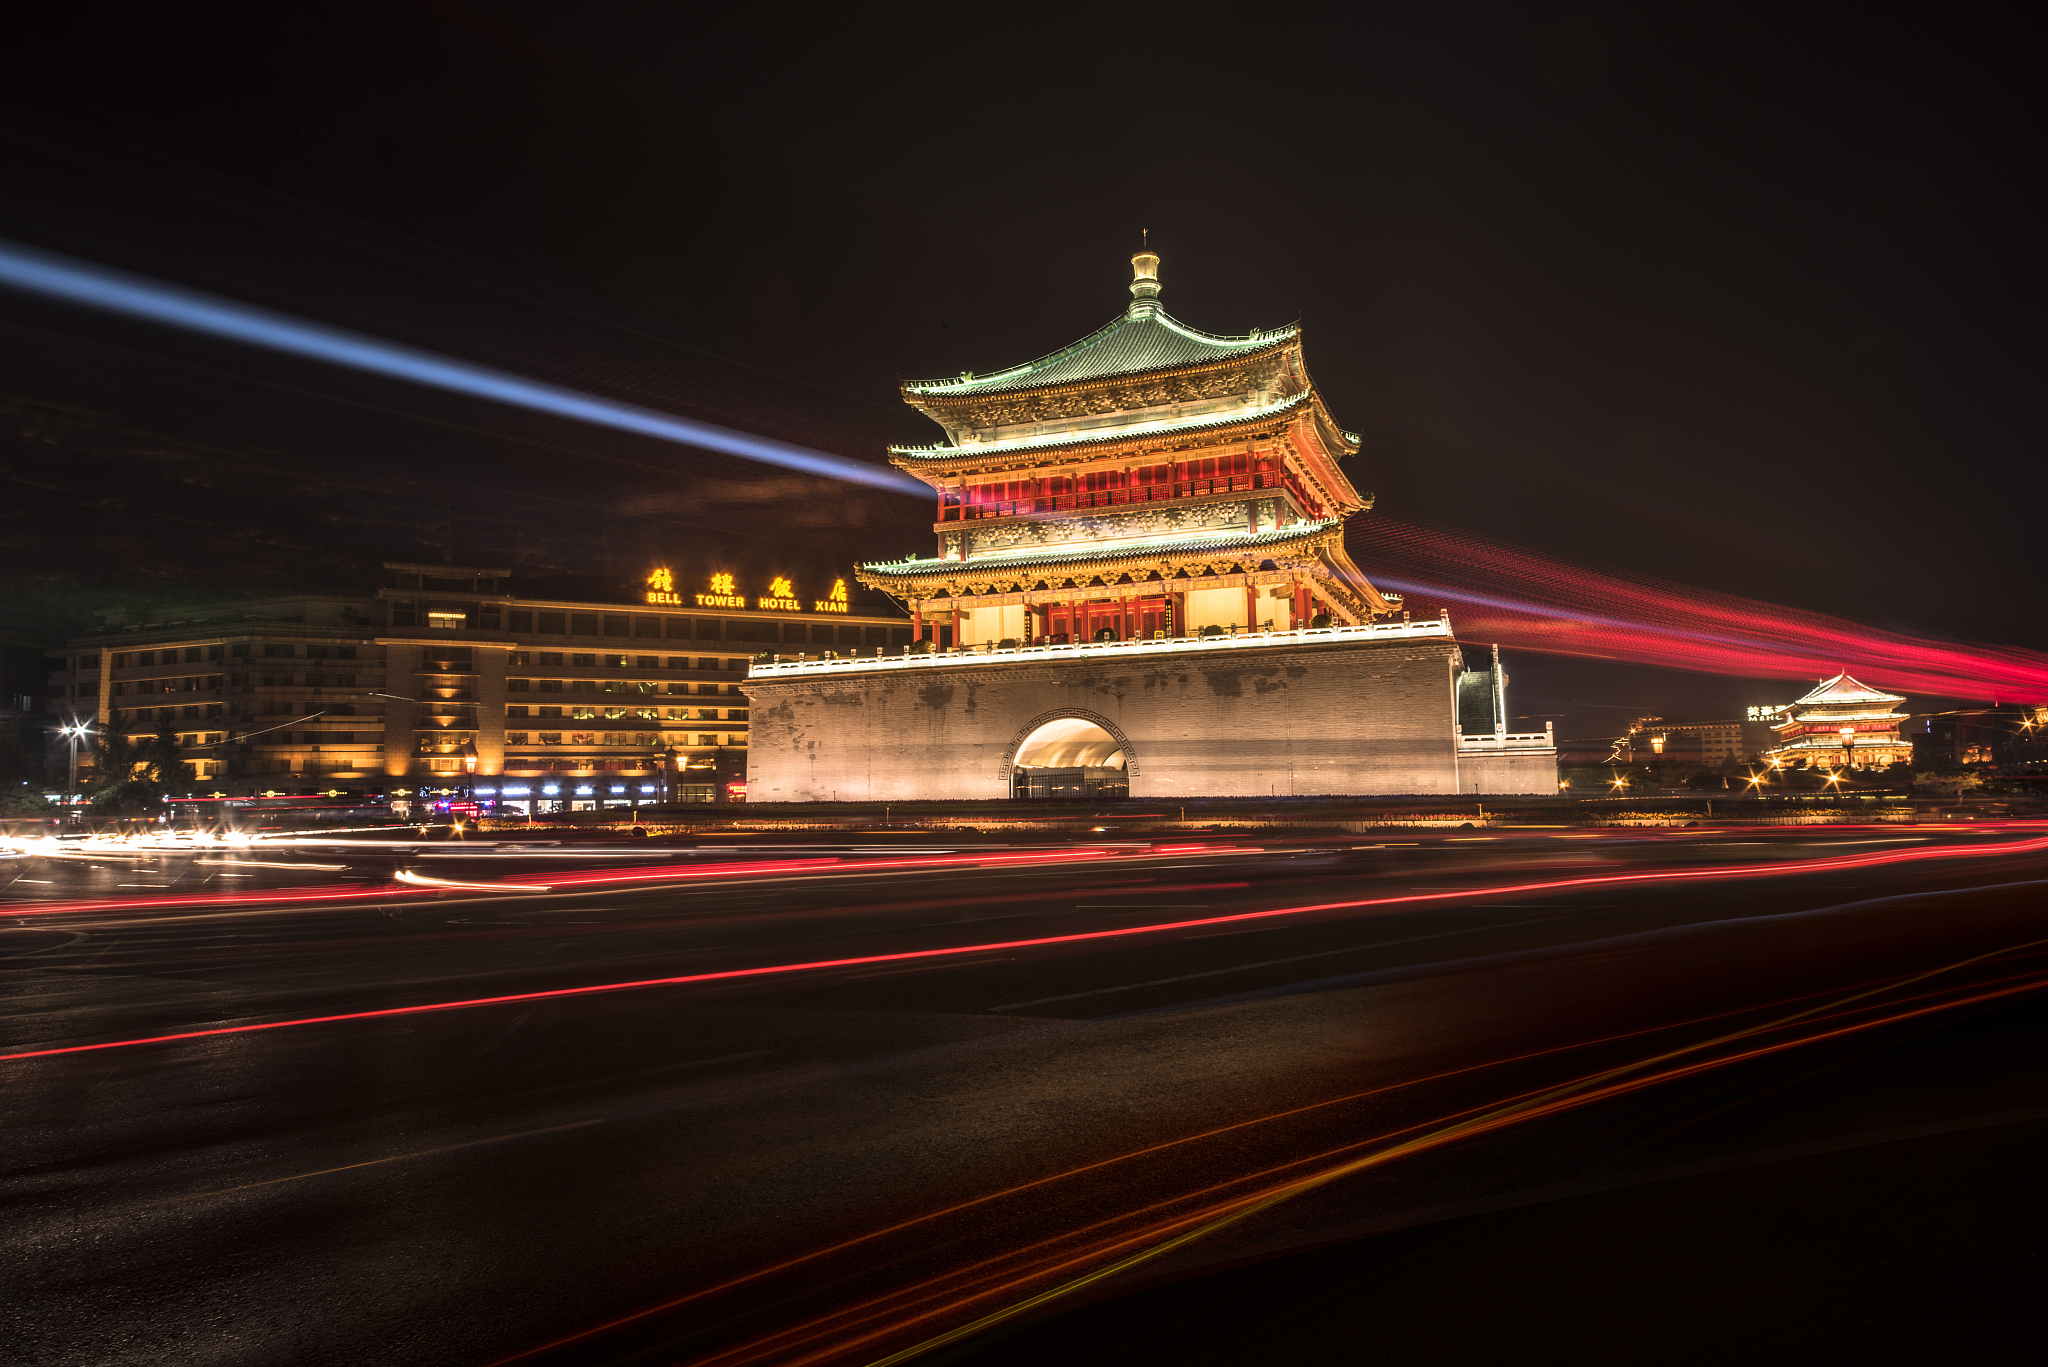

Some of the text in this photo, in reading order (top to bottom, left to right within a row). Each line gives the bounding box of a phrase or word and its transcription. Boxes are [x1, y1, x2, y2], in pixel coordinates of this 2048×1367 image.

[648, 593, 848, 613] BELL TOWER HOTEL XIAN
